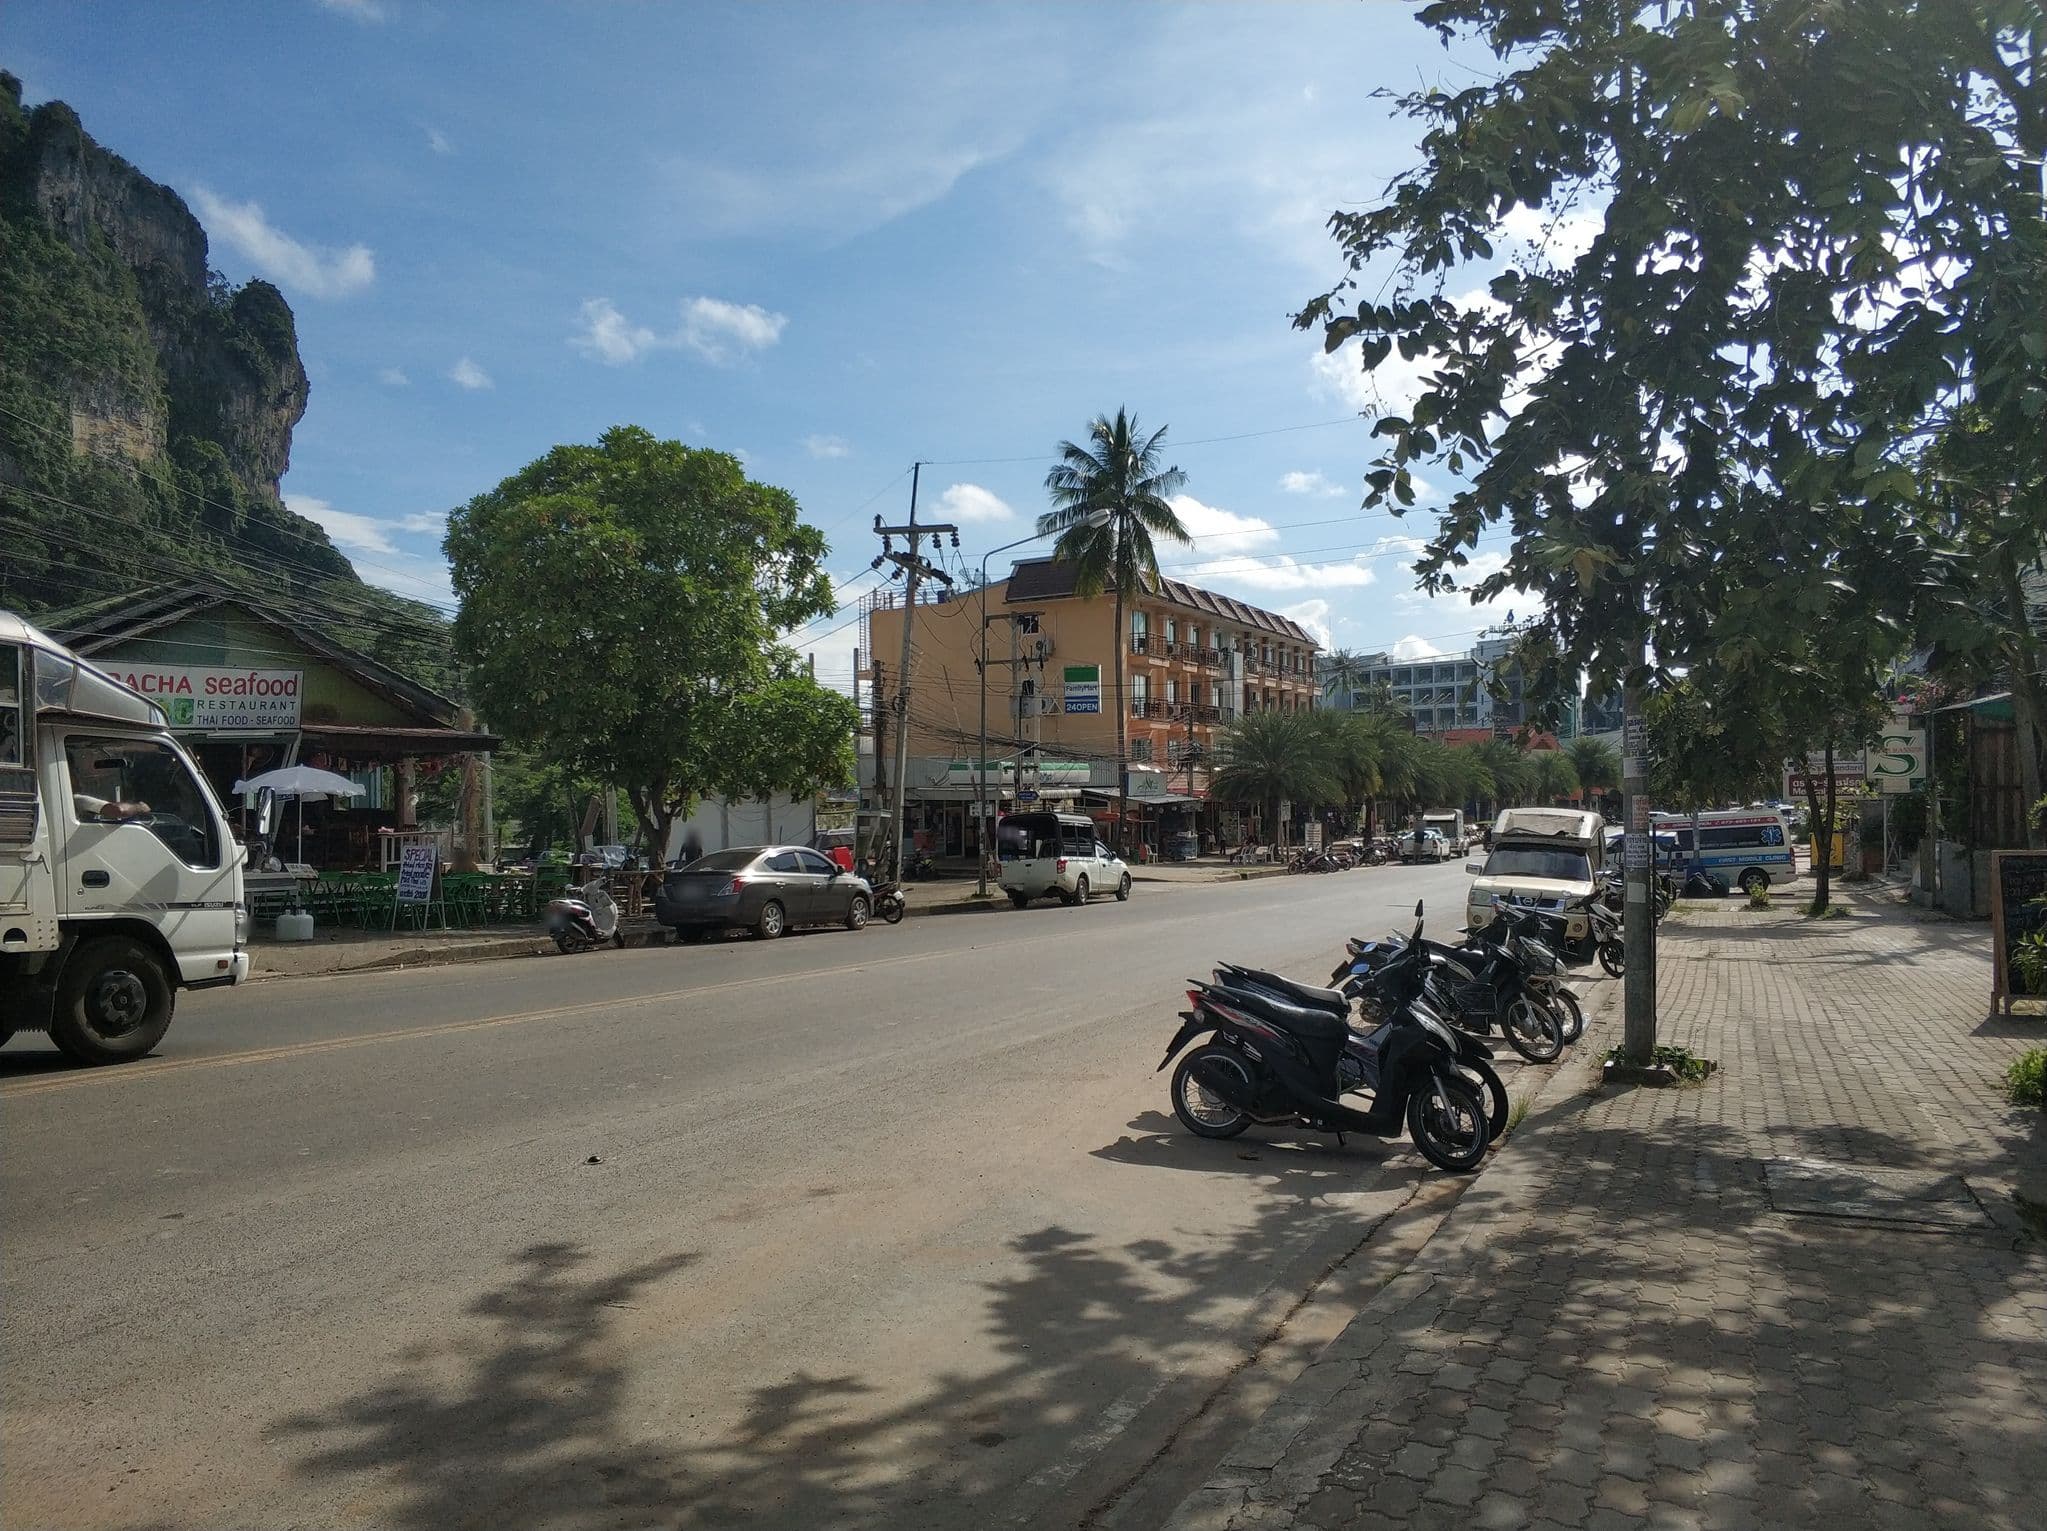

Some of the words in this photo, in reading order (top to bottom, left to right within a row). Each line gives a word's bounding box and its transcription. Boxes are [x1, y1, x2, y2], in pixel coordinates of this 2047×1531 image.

[205, 672, 298, 697] seafood
[197, 700, 297, 711] RESTAURANT
[1066, 703, 1098, 711] 24OPEN
[197, 715, 218, 725] THAI
[221, 715, 249, 725] FOOD
[256, 715, 296, 725] SEAFOOD
